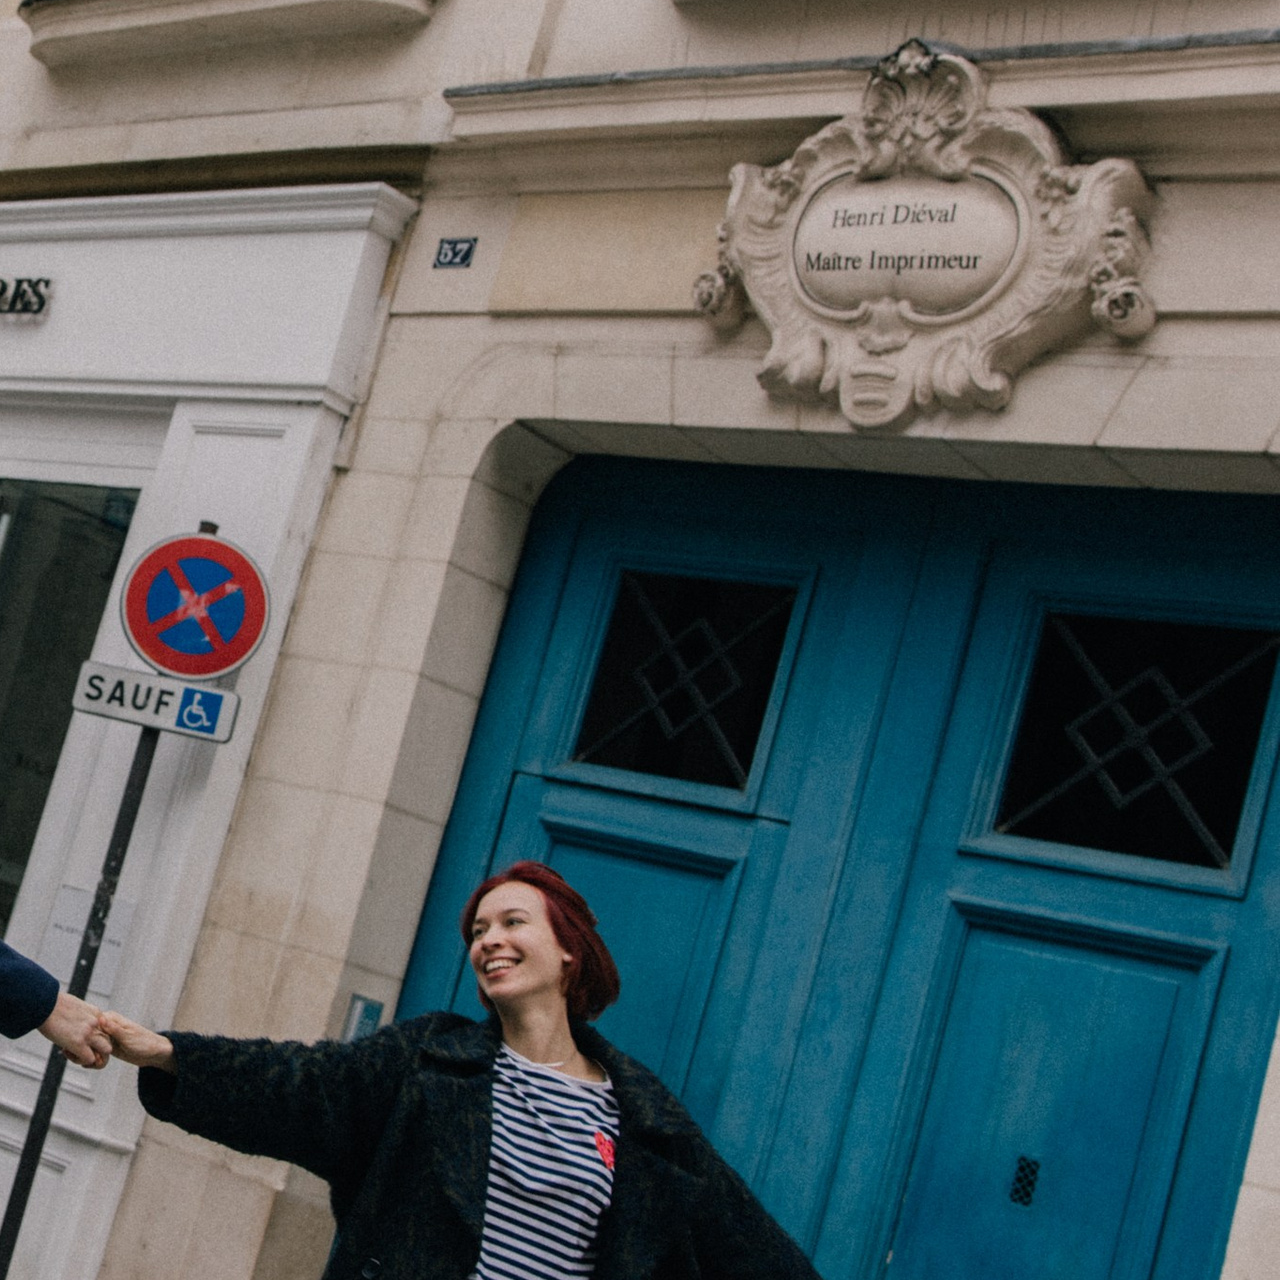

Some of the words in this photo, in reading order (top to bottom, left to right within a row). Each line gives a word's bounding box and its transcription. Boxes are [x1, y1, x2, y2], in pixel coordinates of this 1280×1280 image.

[831, 205, 886, 229] Henri
[891, 203, 957, 226] Diéval
[438, 242, 471, 264] 57
[806, 251, 862, 273] Maître
[869, 249, 982, 275] Imprimeur
[84, 674, 175, 716] SAUF
